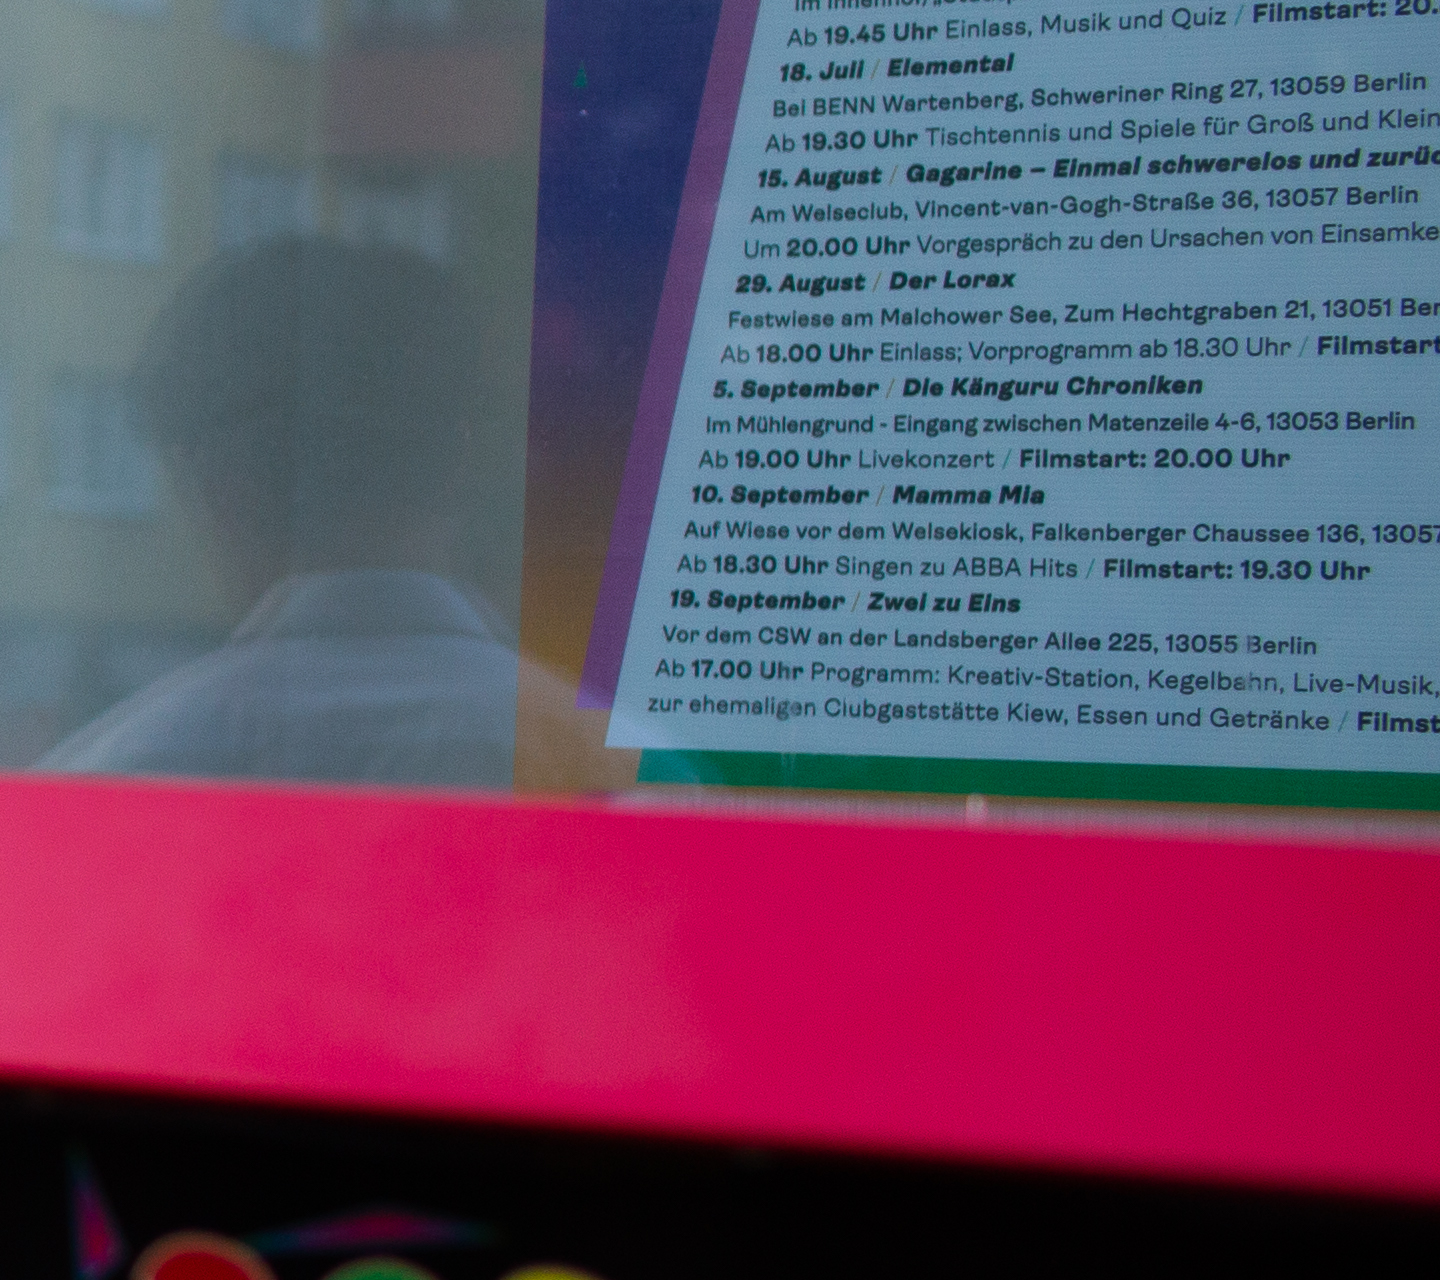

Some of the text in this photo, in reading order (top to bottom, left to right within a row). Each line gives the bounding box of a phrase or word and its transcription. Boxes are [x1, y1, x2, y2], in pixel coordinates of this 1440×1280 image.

[786, 26, 819, 47] Ab
[824, 22, 886, 46] 19.45
[892, 21, 939, 42] Uhr
[945, 17, 1033, 40] Einlass,
[1040, 11, 1112, 34] Musik
[1118, 8, 1164, 31] und
[1170, 5, 1227, 31] Quiz
[780, 51, 1015, 83] 18. Juli Elemental
[772, 71, 1427, 119] Bei BENN Wartenberg, Schweriner Ring 27, 13059 Berlin
[764, 107, 1440, 153] Ab 19.30 Uhr Tischtennis und Spiele für Groß und Klein
[758, 147, 1362, 192] 15. August Gagarine Einmal schwerelos und
[749, 184, 1419, 223] Am Welseclub, Vincent-van-Gogh-Straße 36, 13057 Berlin
[743, 220, 1440, 260] Um 20.00 Uhr Vorgespräch zu den Ursachen von Einsamke
[734, 269, 1016, 298] 29. August Der Lorax
[728, 296, 1392, 330] Festwiese am Malchower See, Zum Hechtgraben 21, 13051
[719, 344, 751, 365] Ab
[756, 342, 823, 364] 18.00
[828, 342, 875, 363] Uhr
[879, 341, 963, 363] Einlass;
[967, 340, 1133, 365] Vorprogramm
[1138, 337, 1169, 358] ab
[1173, 335, 1240, 359] 18.30
[1245, 335, 1293, 357] Uhr
[712, 373, 1204, 403] 5. September Die Känguru Chroniken
[705, 409, 1416, 439] Im Mühlengrund Eingang zwischen Matenzeile 4-6, 13053 Berlin
[698, 447, 1291, 469] Ab 19.00 Uhr Livekonzert Filmstart: 20.00 Uhr
[692, 483, 1046, 509] 10. September Mamma Mia
[683, 519, 1440, 547] Auf Wiese vor dem Welsekiosk, Falkenberger Chaussee 136, 13057
[676, 553, 1372, 581] Ab 18.30 Uhr Singen zu ABBA Hits Filmstart: 19.30 Uhr
[670, 588, 1021, 613] 19. September Zwei zu Eins
